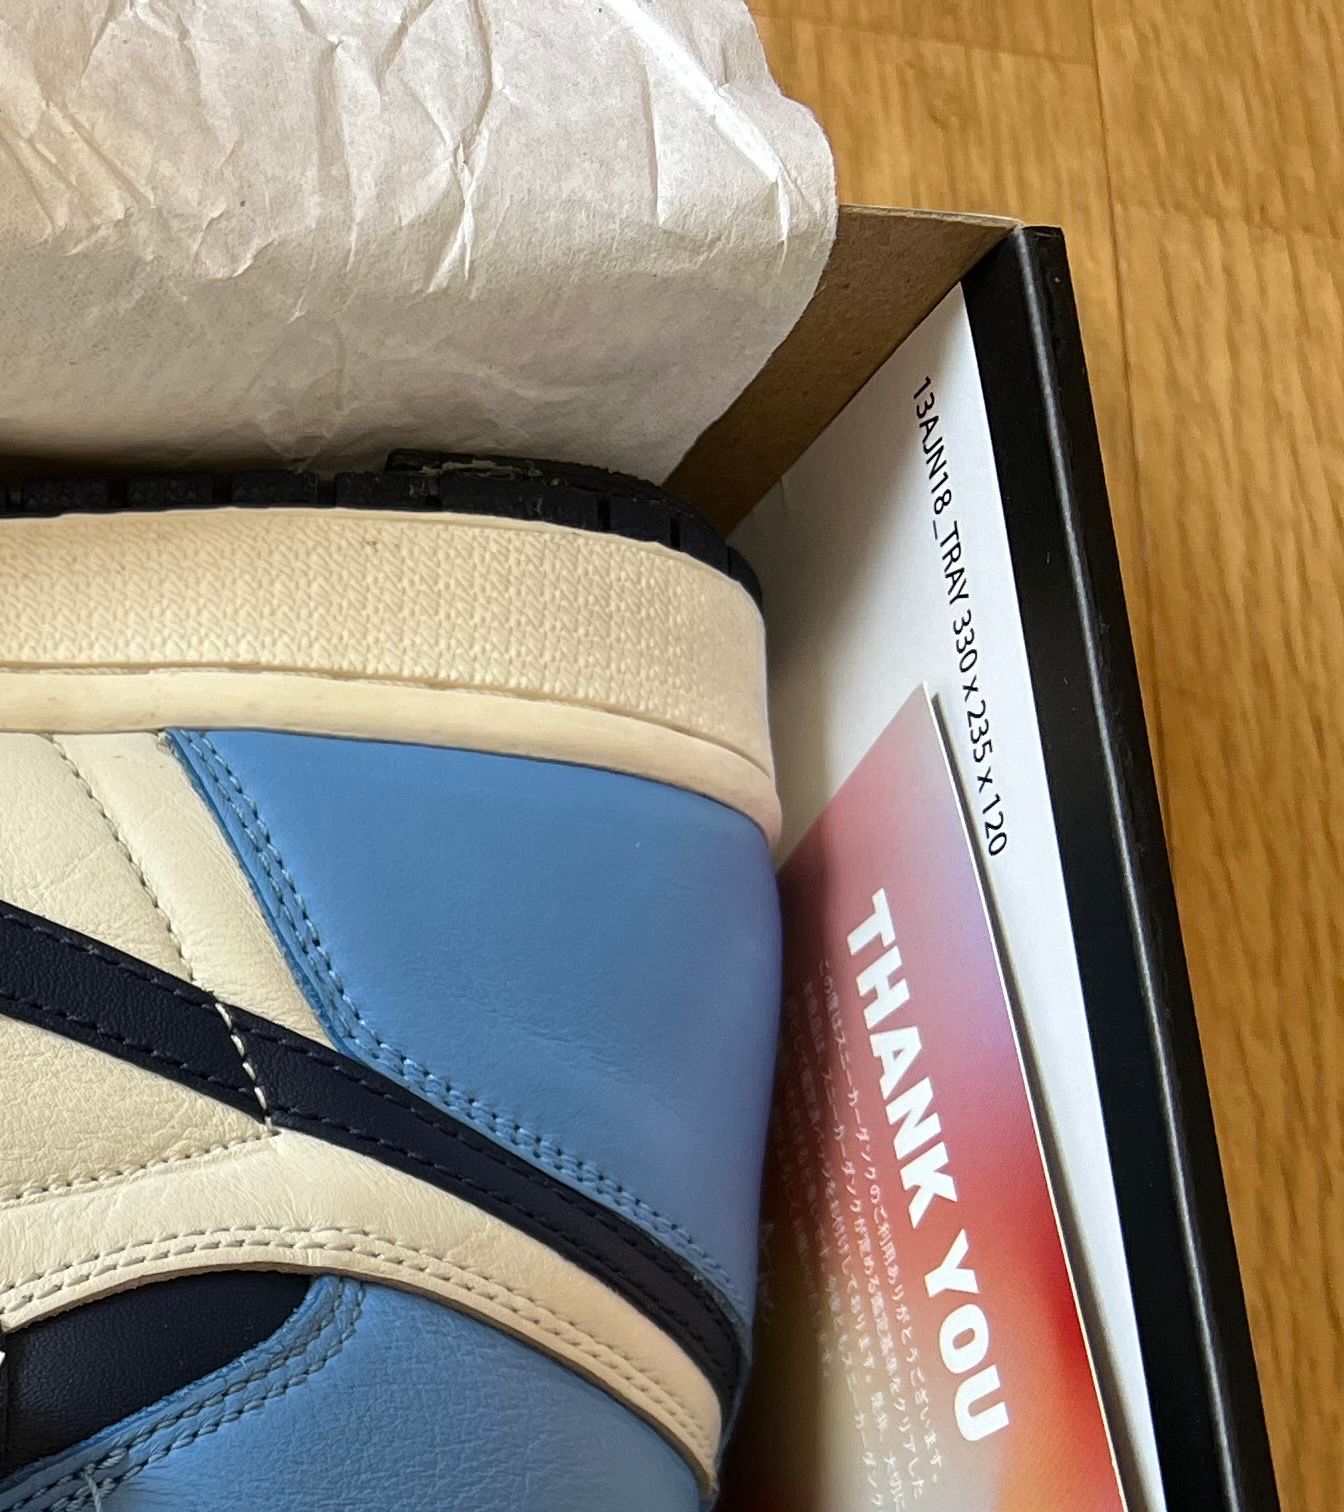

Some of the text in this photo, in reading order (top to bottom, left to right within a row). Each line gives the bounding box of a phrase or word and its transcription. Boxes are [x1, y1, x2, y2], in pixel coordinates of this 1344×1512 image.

[909, 376, 1007, 856] 13AJN18_TRAY 330 x 235 x 120
[848, 888, 1009, 1441] THANK YOU
